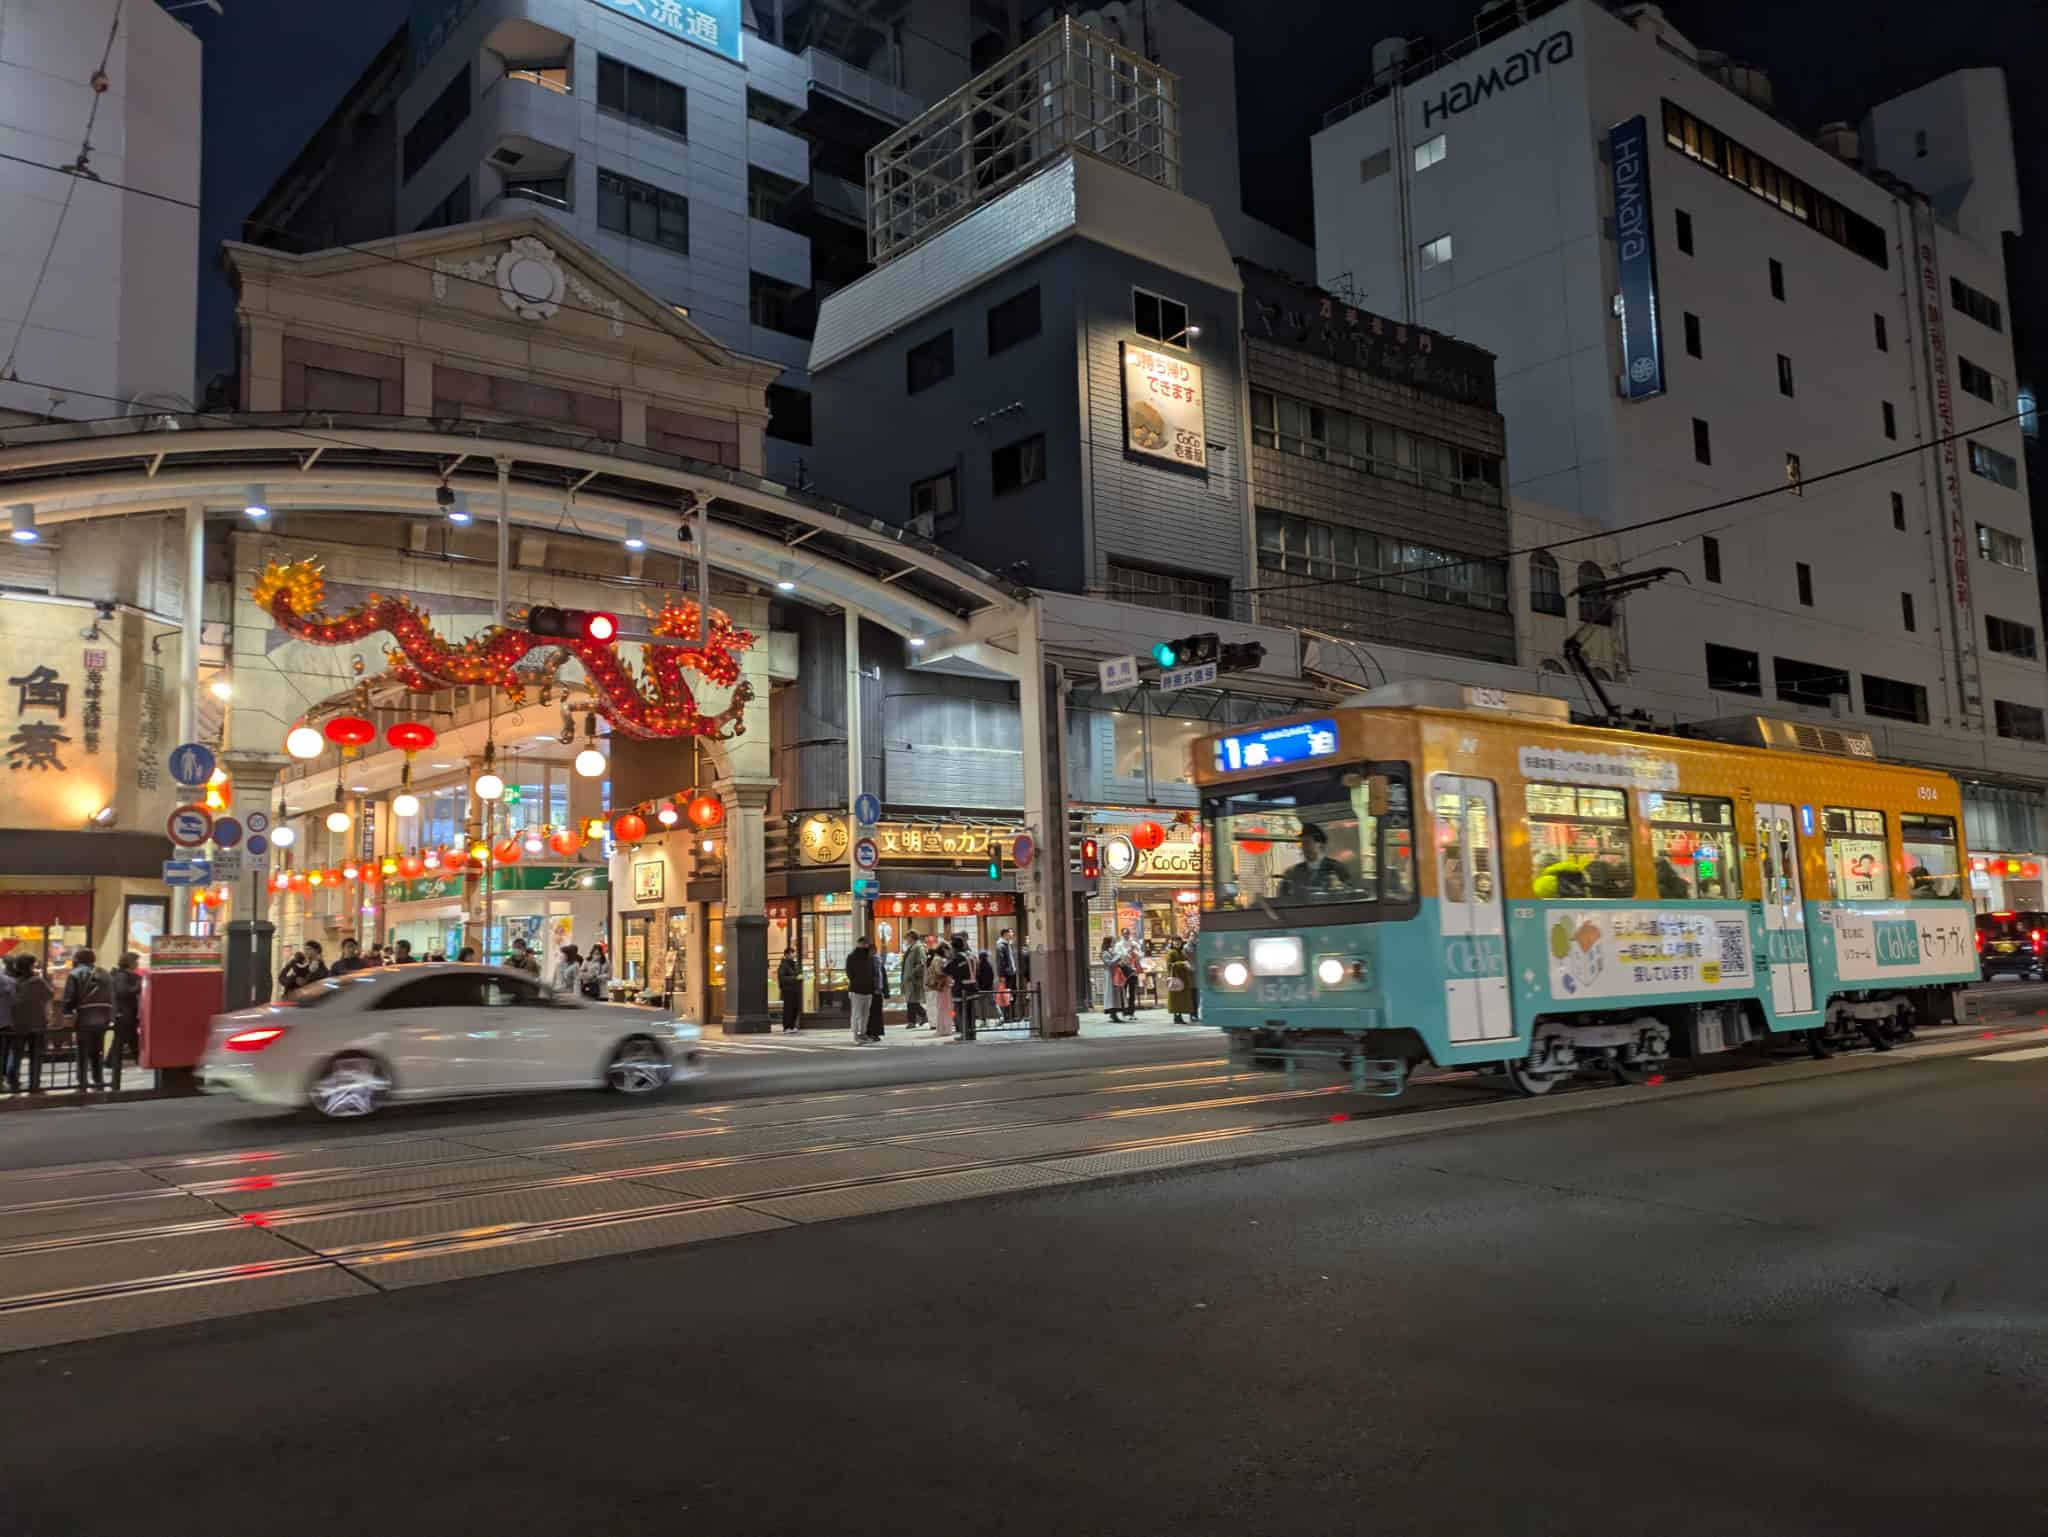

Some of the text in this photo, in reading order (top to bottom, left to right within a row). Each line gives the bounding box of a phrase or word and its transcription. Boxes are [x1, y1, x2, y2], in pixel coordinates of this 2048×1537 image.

[1146, 375, 1196, 402] できます
[6, 665, 72, 771] 角煮
[1916, 786, 1938, 800] 1504
